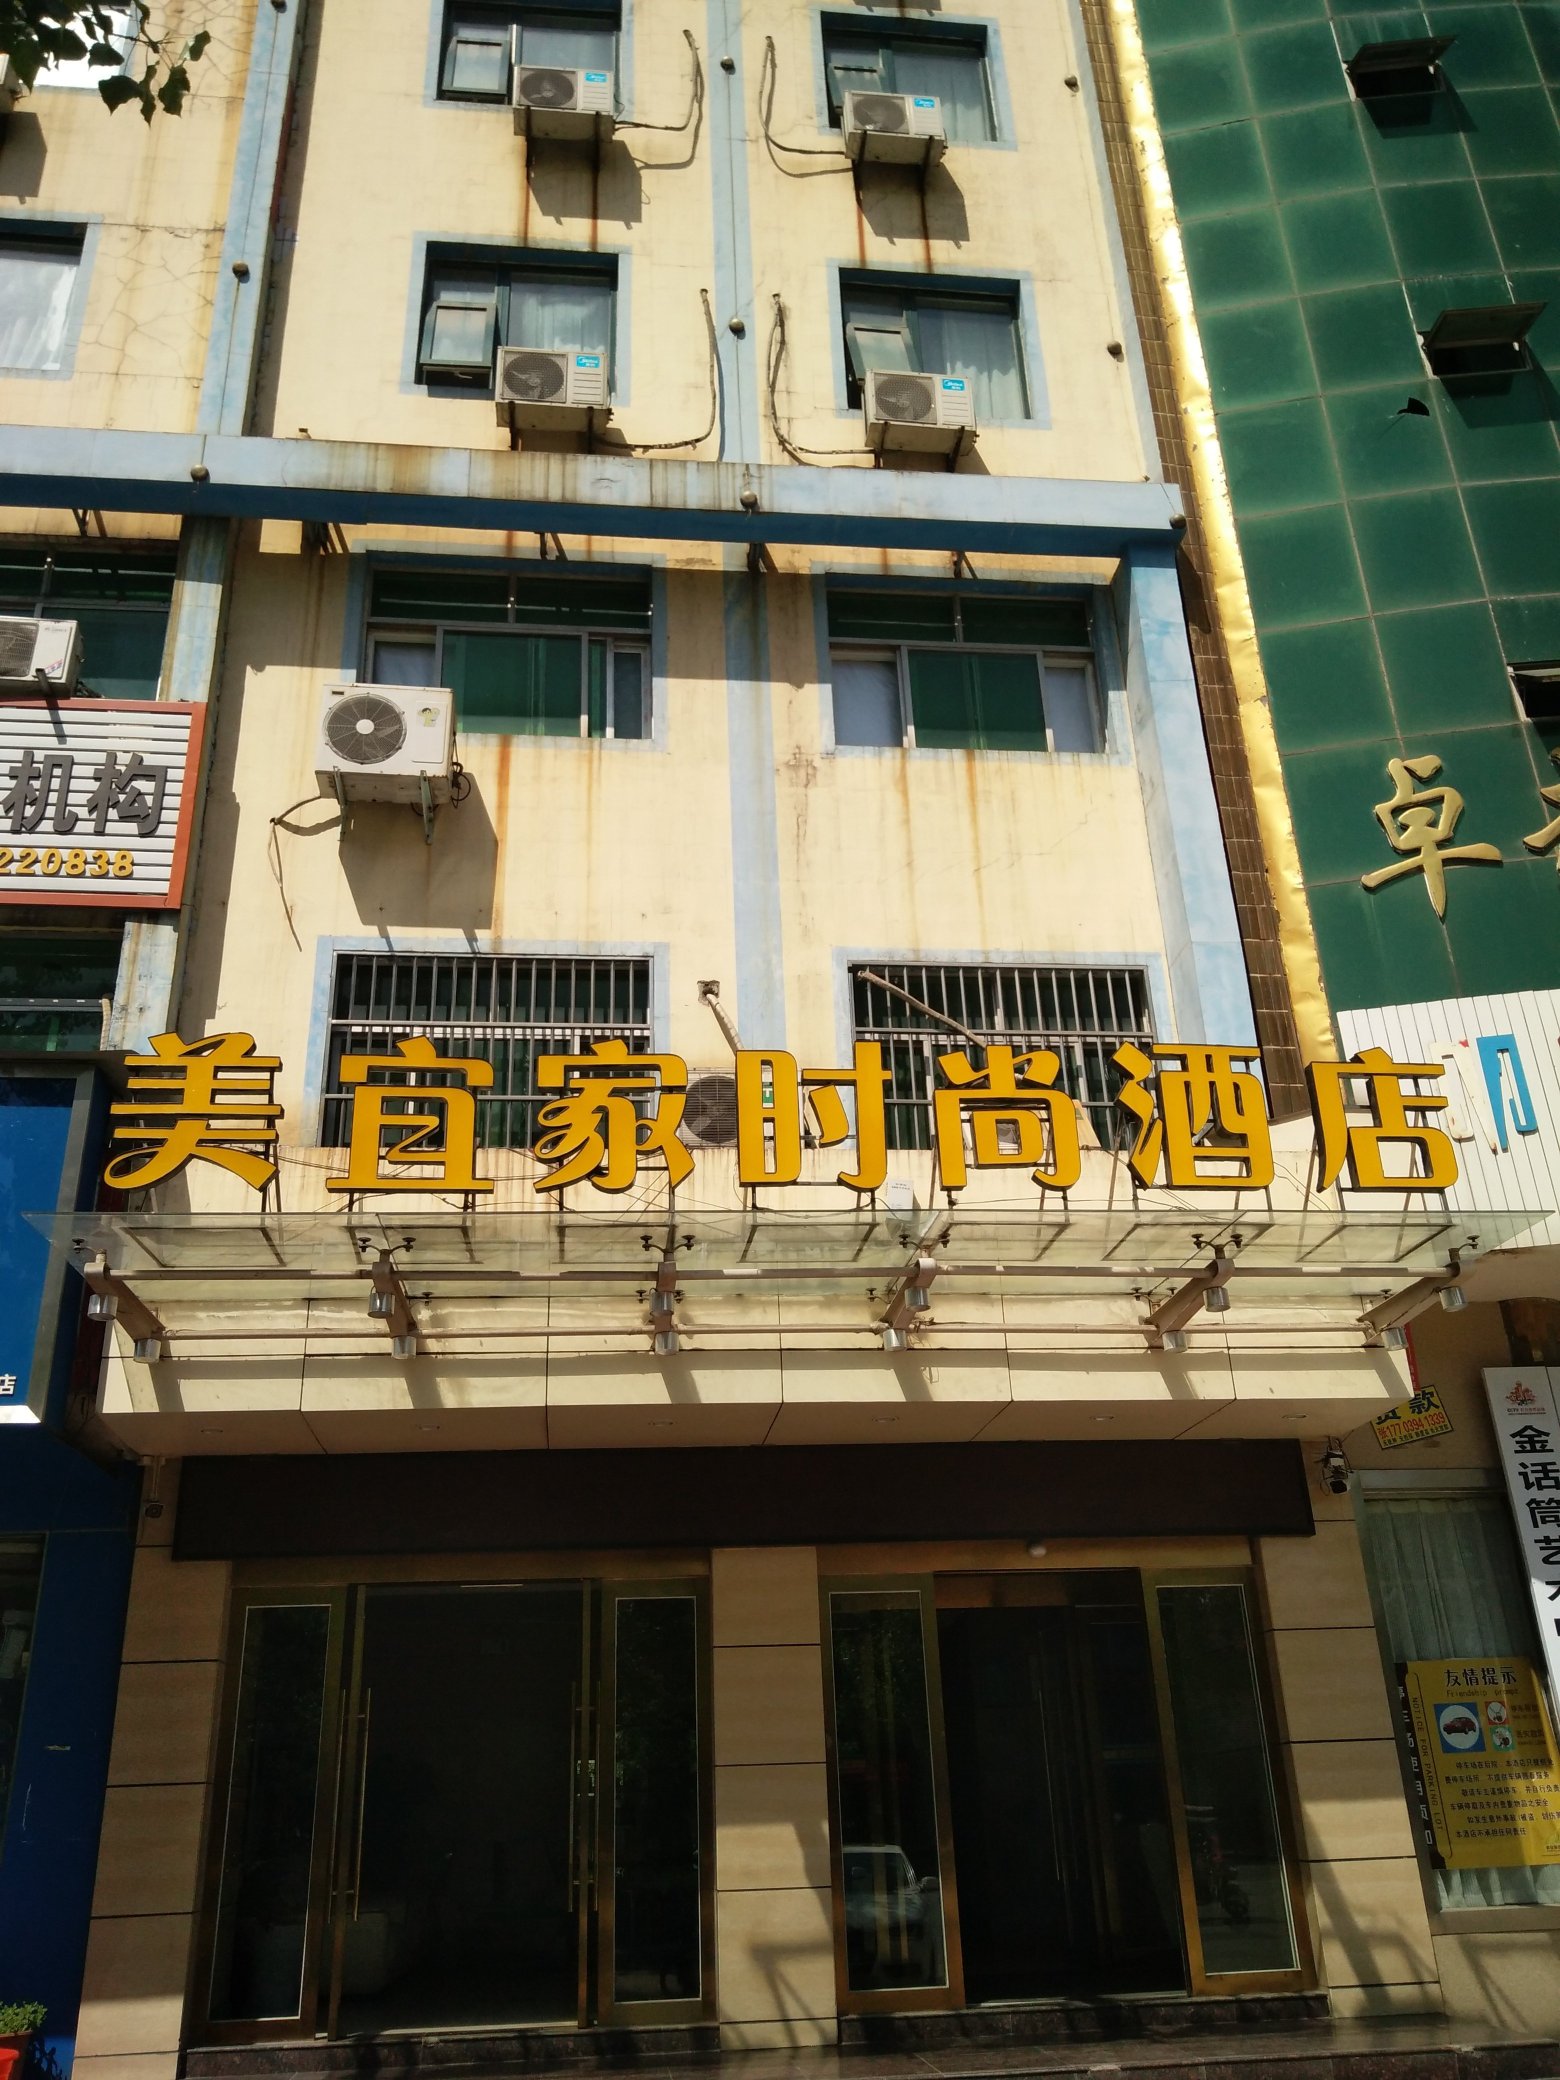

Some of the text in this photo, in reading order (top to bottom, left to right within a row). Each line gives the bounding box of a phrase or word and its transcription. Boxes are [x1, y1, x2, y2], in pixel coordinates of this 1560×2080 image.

[2, 750, 168, 838] 机构
[0, 847, 134, 877] 220838
[103, 1031, 1459, 1193] 美宜家时尚酒店
[1509, 1424, 1560, 1637] 金话筒艺
[1444, 1665, 1517, 1688] 友情提示
[1412, 1697, 1443, 1831] NOTICE FOR PARKING LOT
